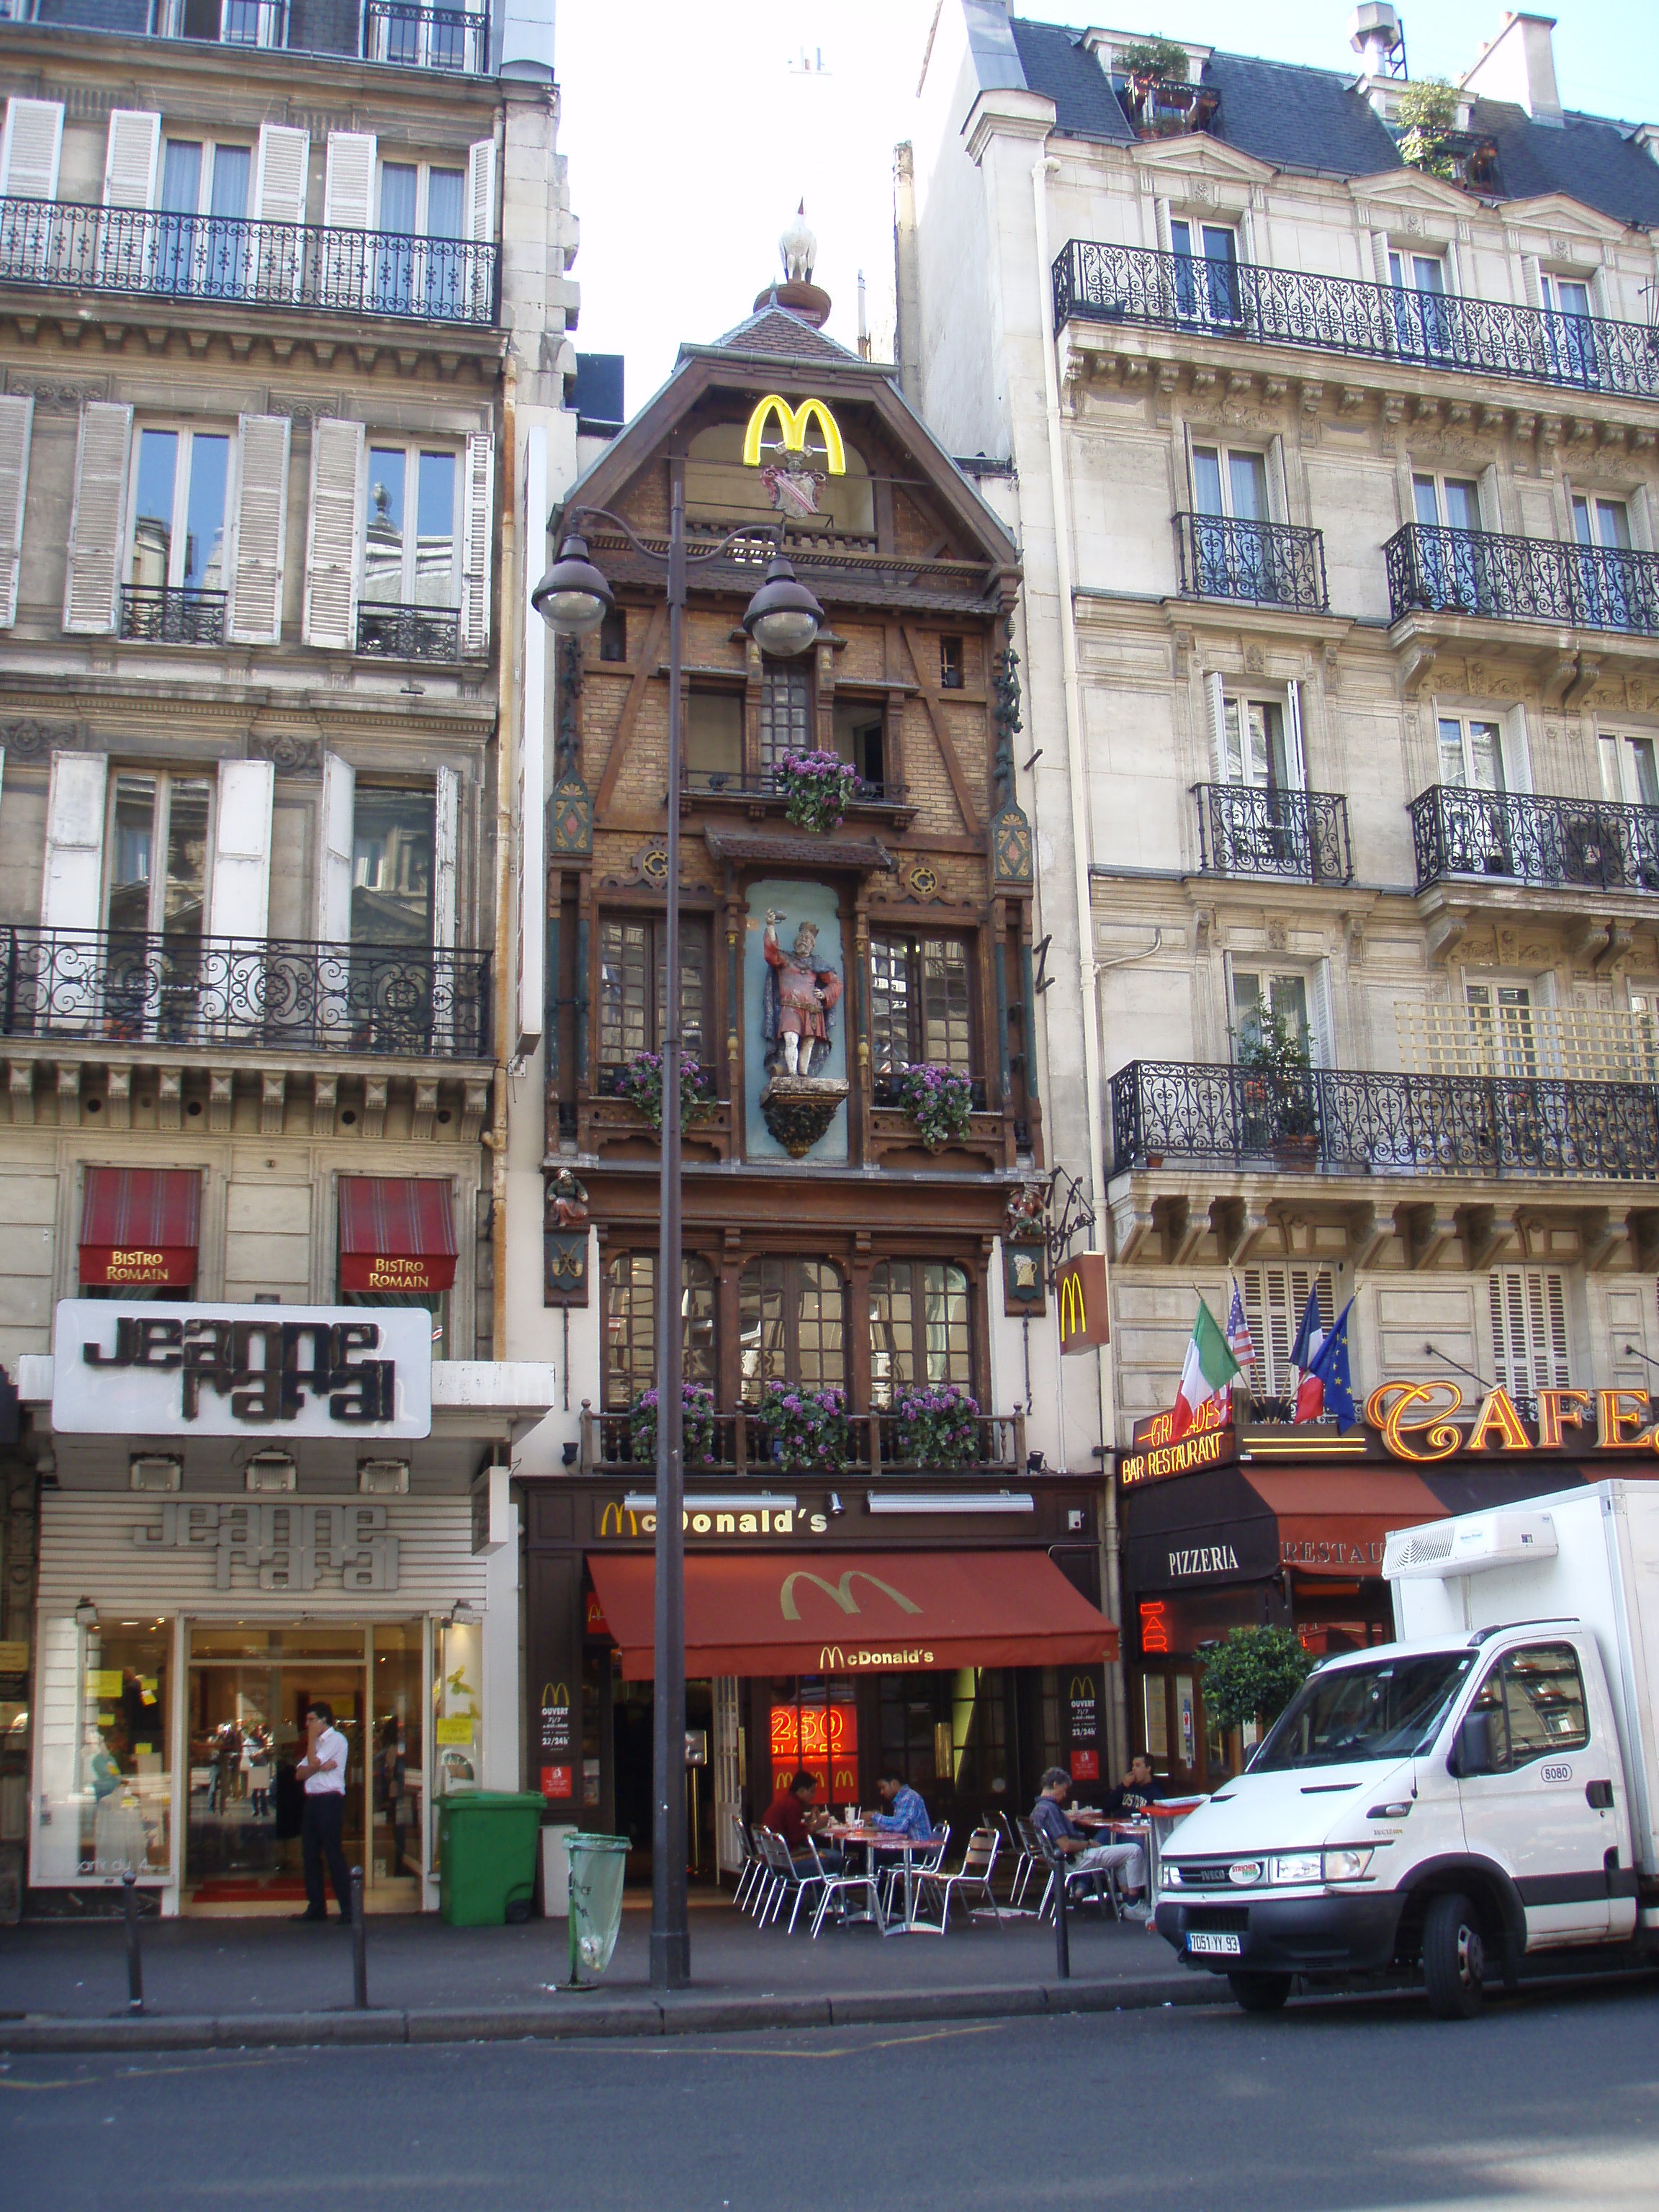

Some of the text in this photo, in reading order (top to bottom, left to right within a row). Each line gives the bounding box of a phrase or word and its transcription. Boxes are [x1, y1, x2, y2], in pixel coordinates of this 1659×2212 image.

[106, 1266, 168, 1280] ROMAIN
[369, 1273, 429, 1287] ROMAIN
[1363, 1380, 1652, 1462] CAFE
[1122, 1431, 1224, 1484] BAR RESTAURANT
[601, 1501, 828, 1536] Mconald's
[1169, 1545, 1239, 1576] PIZZERIA
[819, 1646, 935, 1670] McDonald's
[541, 1707, 569, 1716] OUVERT
[1071, 1699, 1095, 1708] OUVERT
[772, 1709, 843, 1740] 250
[1545, 1767, 1568, 1779] 5080
[1200, 1869, 1225, 1881] IVECO
[1191, 1935, 1238, 1951] 7051 YY 93
